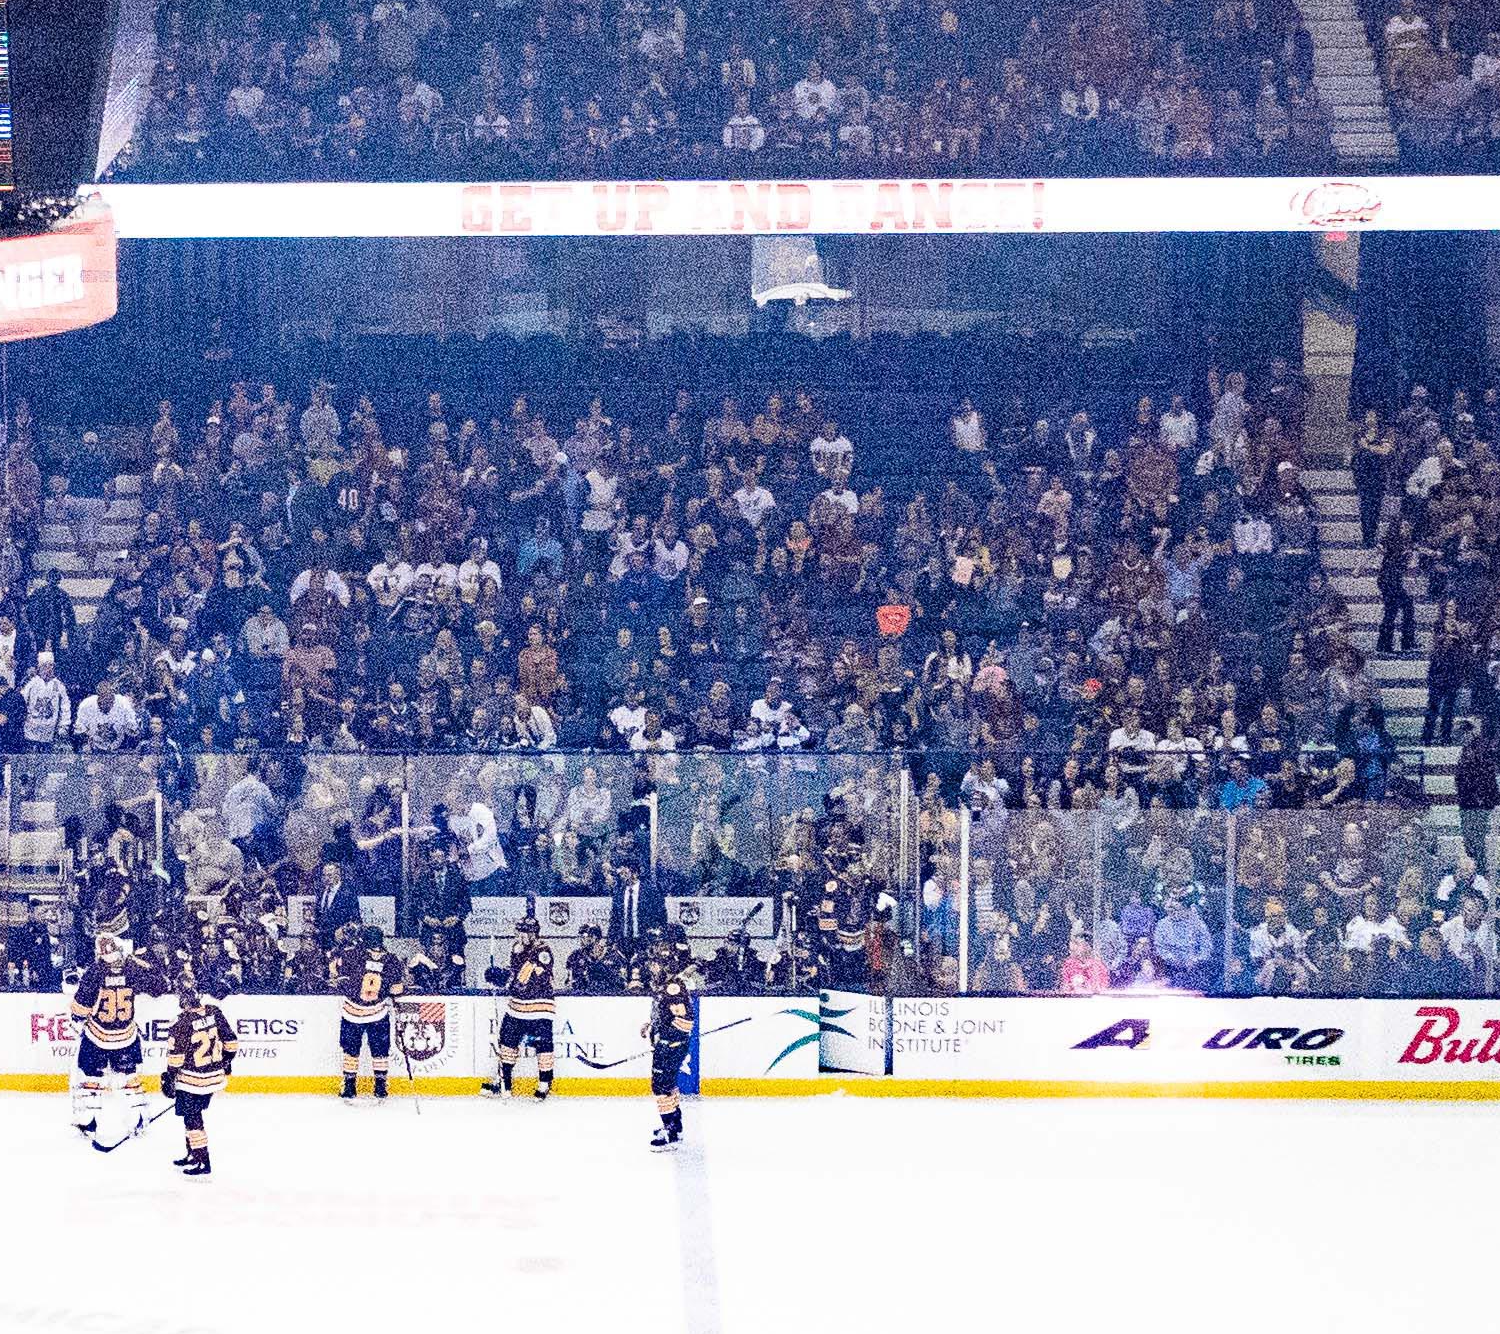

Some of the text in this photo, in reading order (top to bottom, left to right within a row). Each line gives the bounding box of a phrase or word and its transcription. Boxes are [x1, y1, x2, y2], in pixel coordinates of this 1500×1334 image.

[591, 184, 671, 233] UP
[98, 987, 133, 1024] 35
[30, 1012, 171, 1043] RENE
[933, 1019, 946, 1034] &
[954, 1019, 1007, 1035] JOINT
[489, 1041, 605, 1059] MCINE
[1285, 1055, 1342, 1066] TIRES
